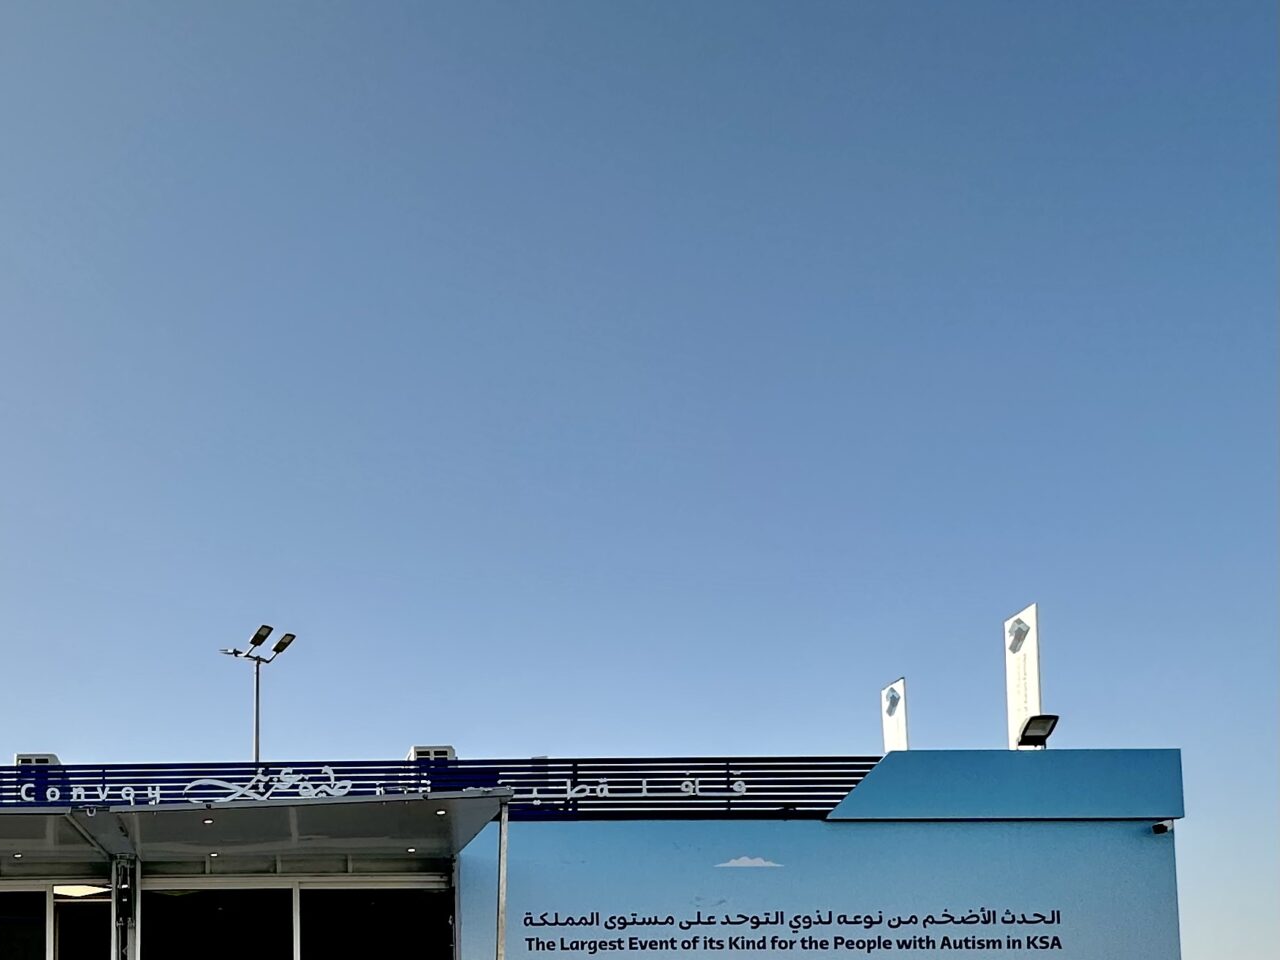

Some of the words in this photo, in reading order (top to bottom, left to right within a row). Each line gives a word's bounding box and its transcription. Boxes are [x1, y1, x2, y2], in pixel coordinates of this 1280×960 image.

[523, 911, 599, 927] المملكة
[604, 913, 675, 930] مستوى
[679, 911, 716, 930] على
[721, 911, 784, 929] التوحد
[789, 910, 832, 934] لذوي
[837, 910, 883, 928] نوعه
[888, 914, 918, 928] من
[922, 907, 997, 928] الأضخم
[1001, 909, 1061, 925] الحدث
[525, 937, 556, 951] The
[560, 937, 624, 954] Largest
[629, 937, 678, 950] Event
[681, 935, 700, 950] of
[703, 936, 725, 950] its
[729, 936, 767, 950] Kind
[770, 935, 797, 950] for
[800, 936, 829, 950] the
[834, 936, 892, 953] People
[896, 936, 936, 950] with
[940, 936, 1002, 950] Autism
[1006, 936, 1021, 950] in
[1026, 936, 1062, 950] KSA
